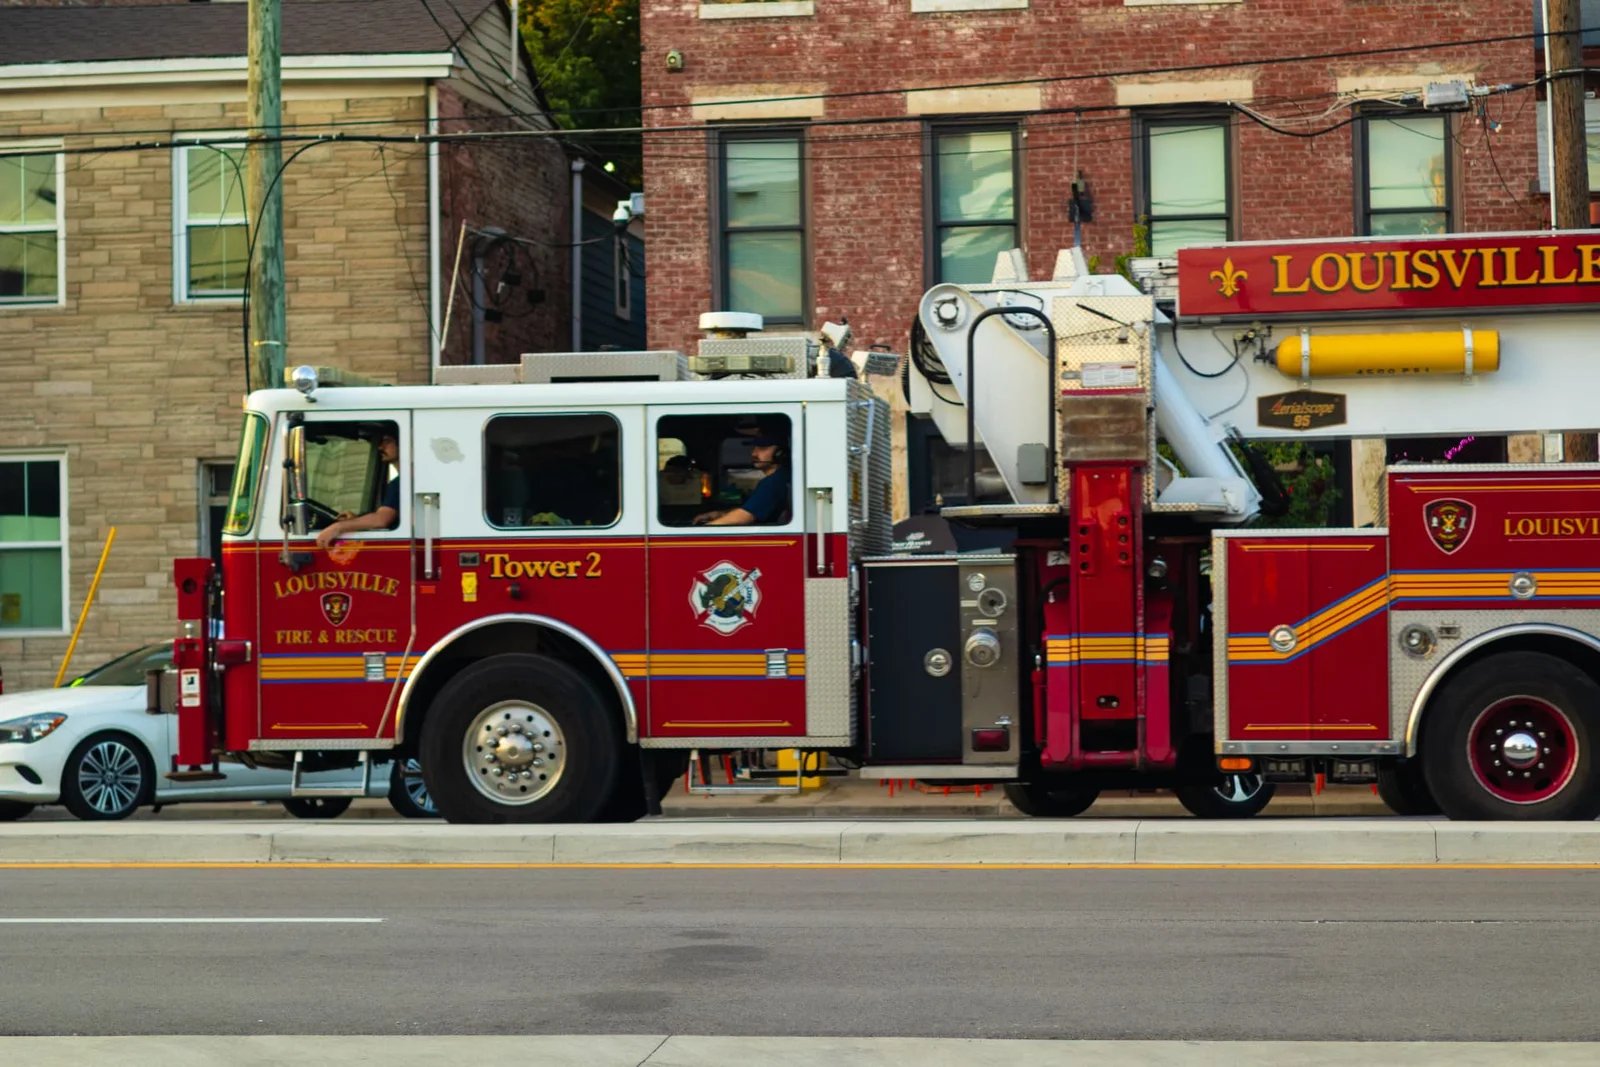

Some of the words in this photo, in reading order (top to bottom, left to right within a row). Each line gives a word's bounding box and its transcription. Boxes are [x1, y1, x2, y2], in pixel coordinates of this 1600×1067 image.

[1272, 244, 1600, 293] LOUISVILLE
[484, 553, 582, 578] Tower
[585, 551, 602, 577] 2
[273, 571, 400, 599] LOUISVILLE
[275, 629, 312, 644] FIRE
[318, 629, 329, 643] &
[335, 628, 397, 643] RESCUE
